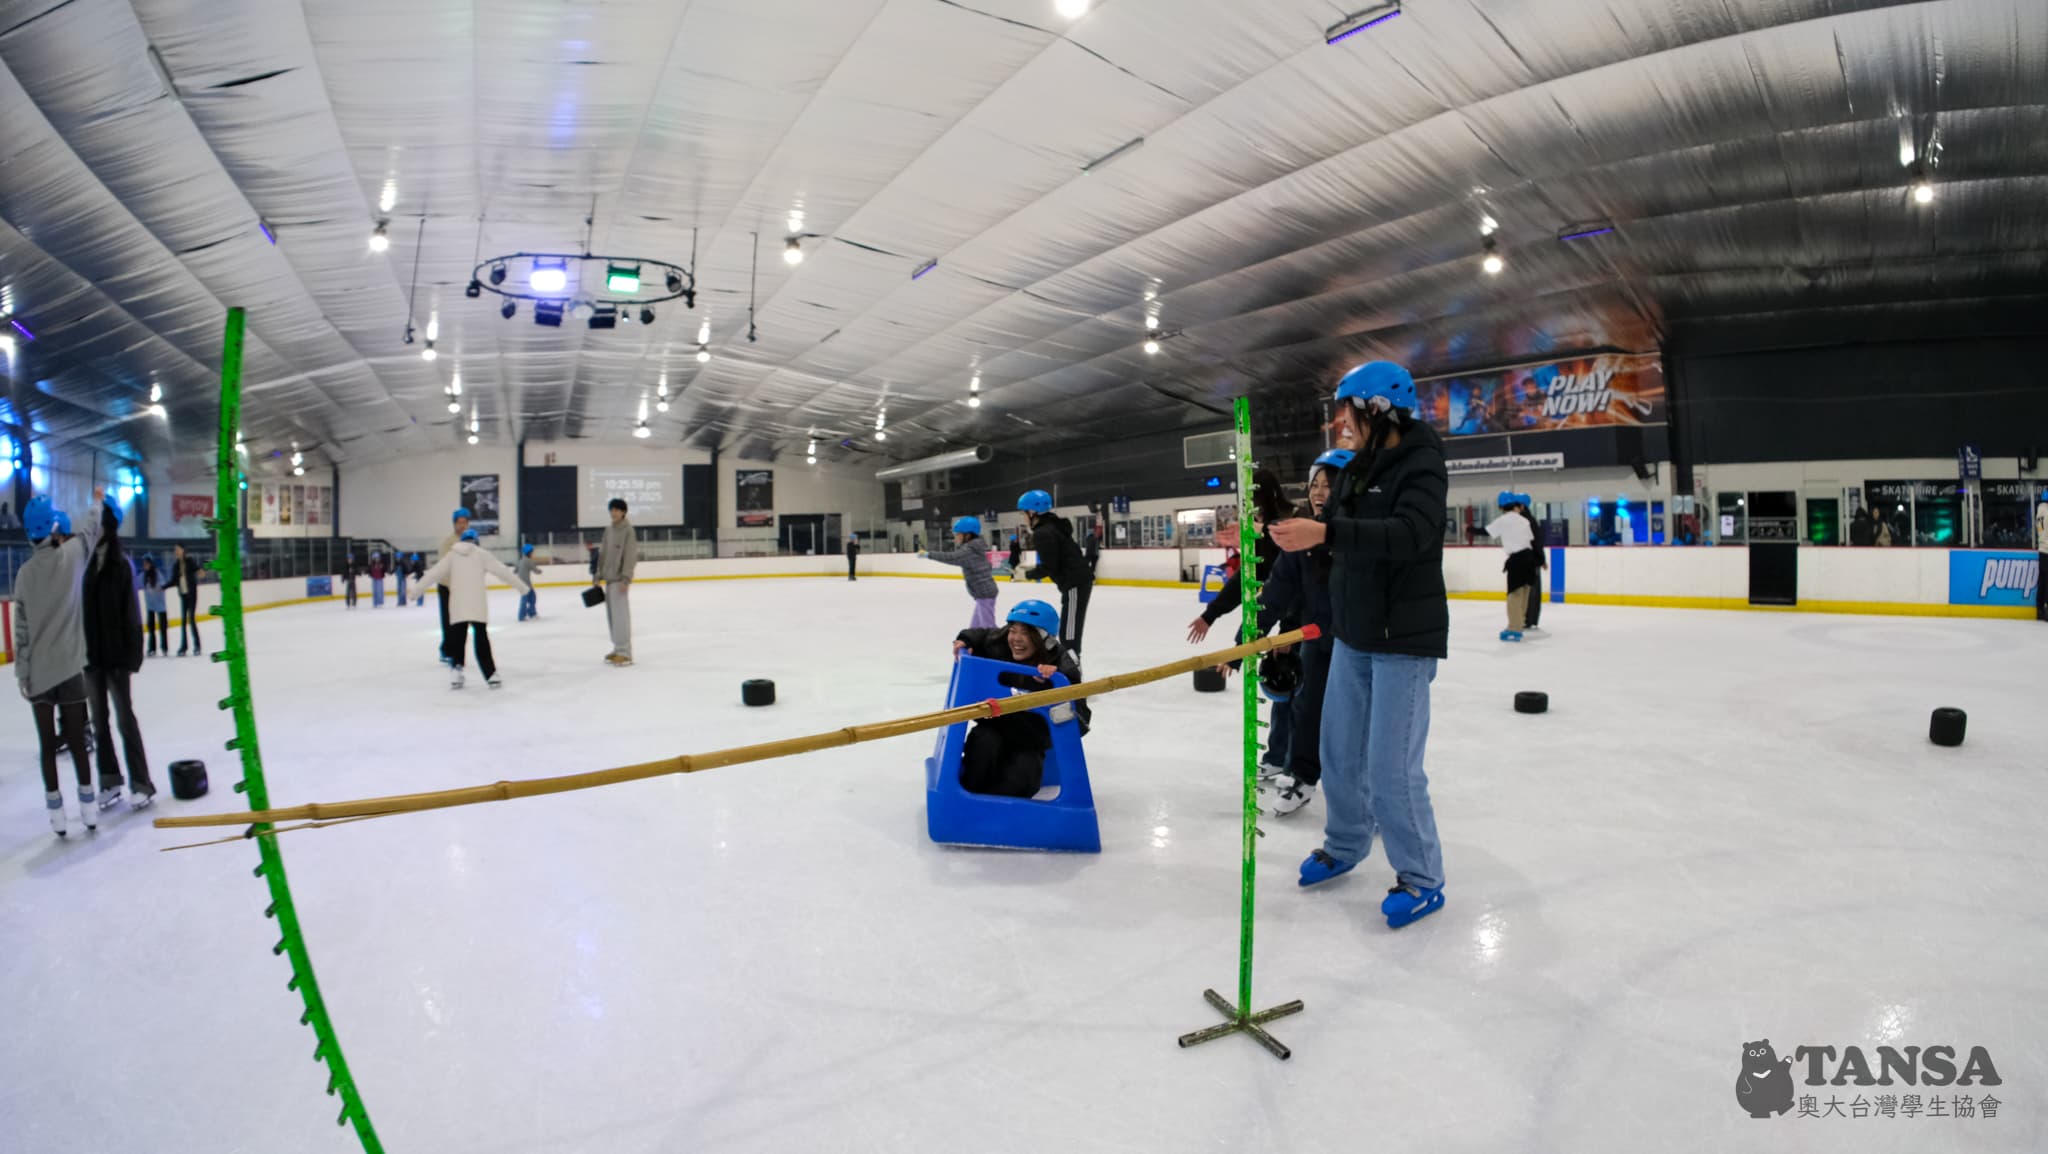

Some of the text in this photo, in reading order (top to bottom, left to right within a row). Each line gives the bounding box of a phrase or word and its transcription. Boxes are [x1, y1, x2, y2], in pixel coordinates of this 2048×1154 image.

[1547, 370, 1613, 396] PLAY
[1542, 391, 1611, 416] NOW!
[1996, 484, 2025, 496] SKATE
[1979, 558, 2040, 598] pump
